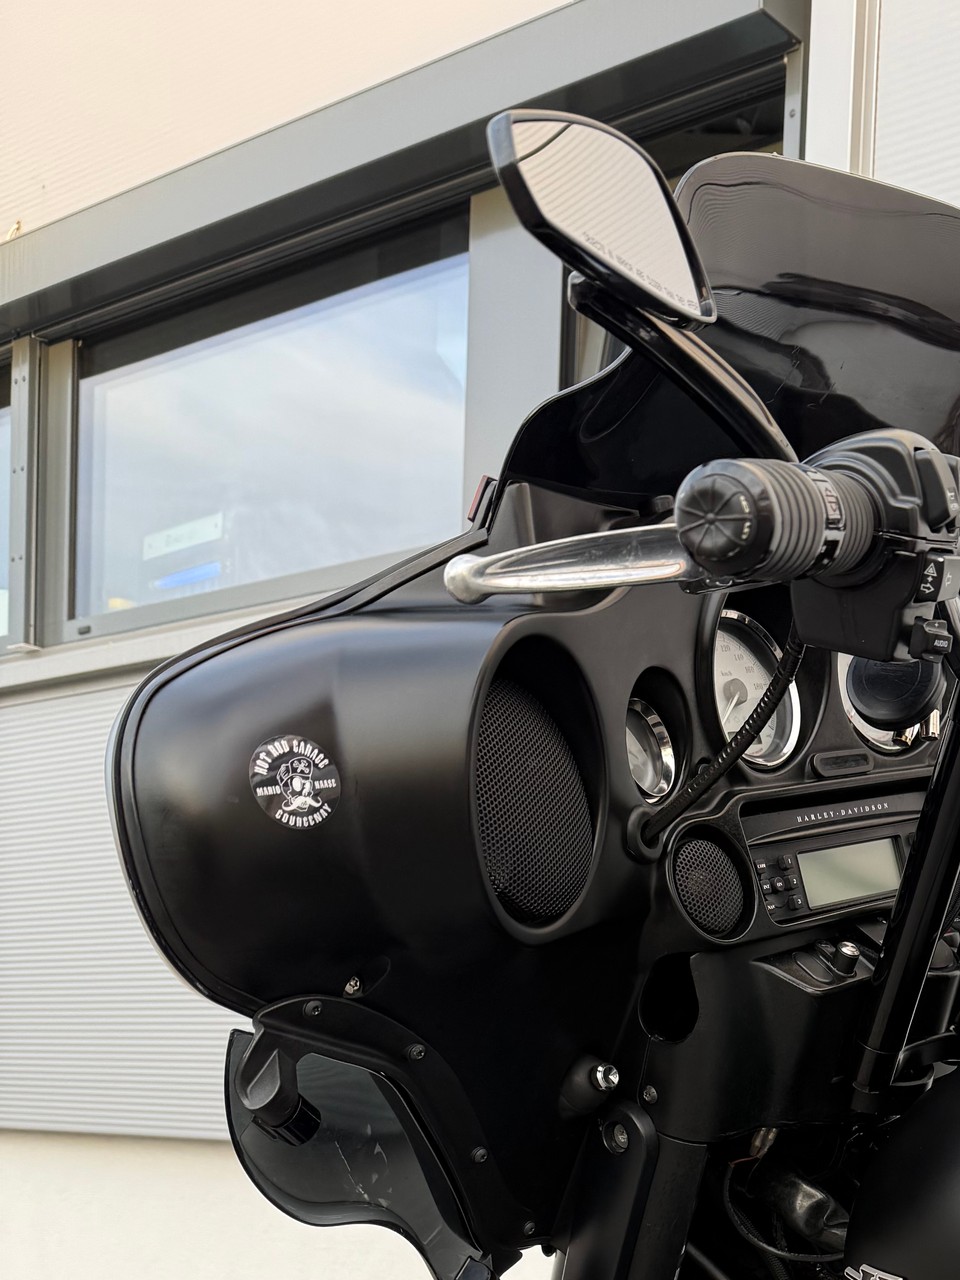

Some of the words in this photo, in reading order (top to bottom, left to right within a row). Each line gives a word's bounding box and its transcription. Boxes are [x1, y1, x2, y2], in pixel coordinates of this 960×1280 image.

[933, 638, 949, 648] AUDIO
[254, 752, 272, 775] HOT
[267, 739, 290, 757] ROD
[256, 785, 281, 796] MARIO
